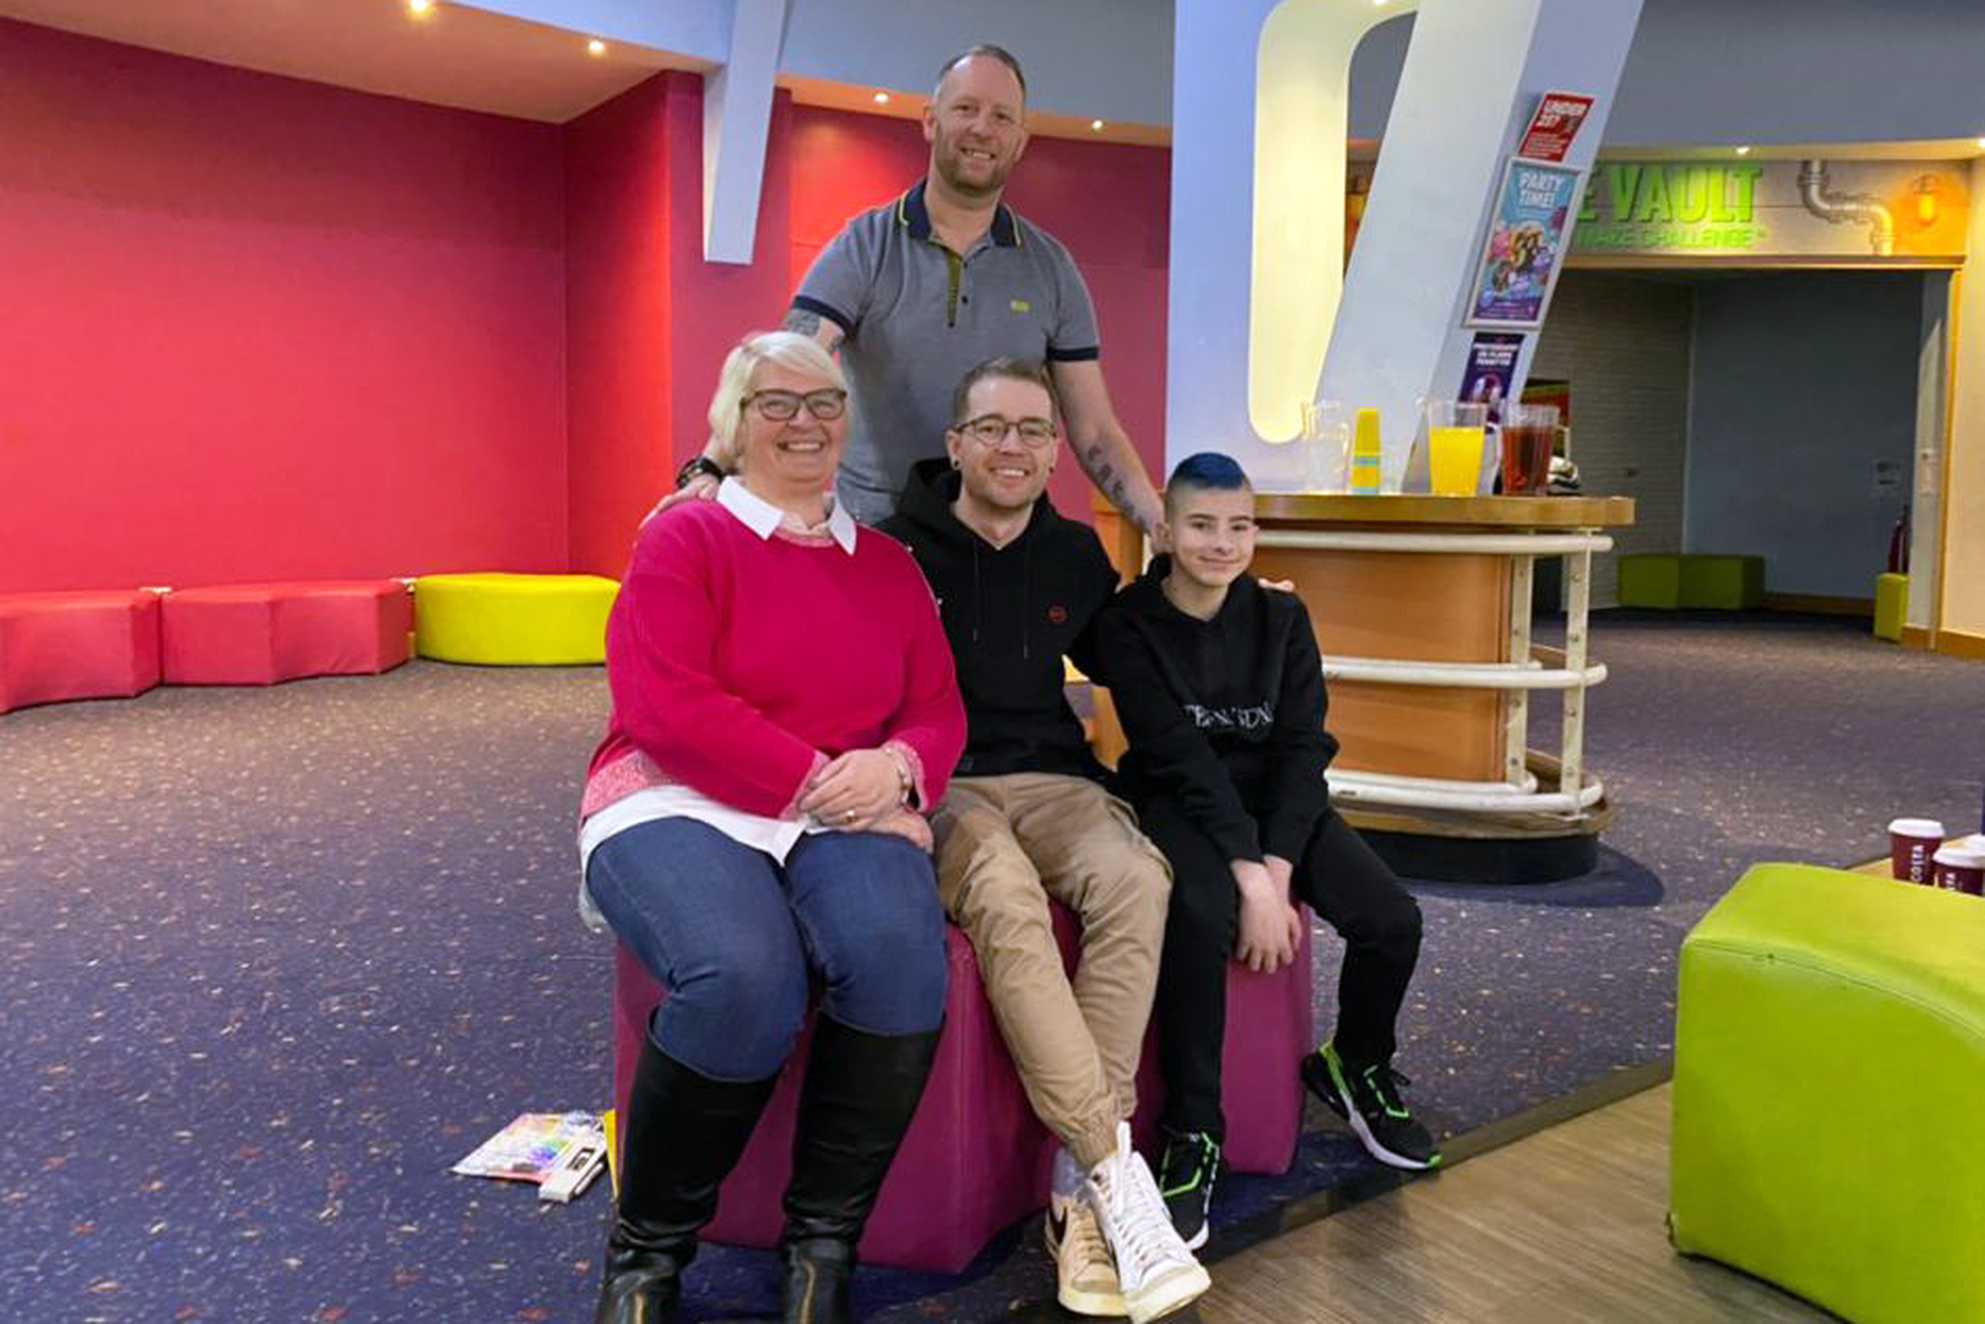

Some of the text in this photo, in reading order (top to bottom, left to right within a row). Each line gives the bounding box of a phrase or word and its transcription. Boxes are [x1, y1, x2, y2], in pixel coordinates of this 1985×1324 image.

[1519, 172, 1564, 191] PARTY
[1611, 165, 1763, 222] VAULT
[1519, 189, 1555, 208] TIME!
[1910, 845, 1924, 882] COSTA
